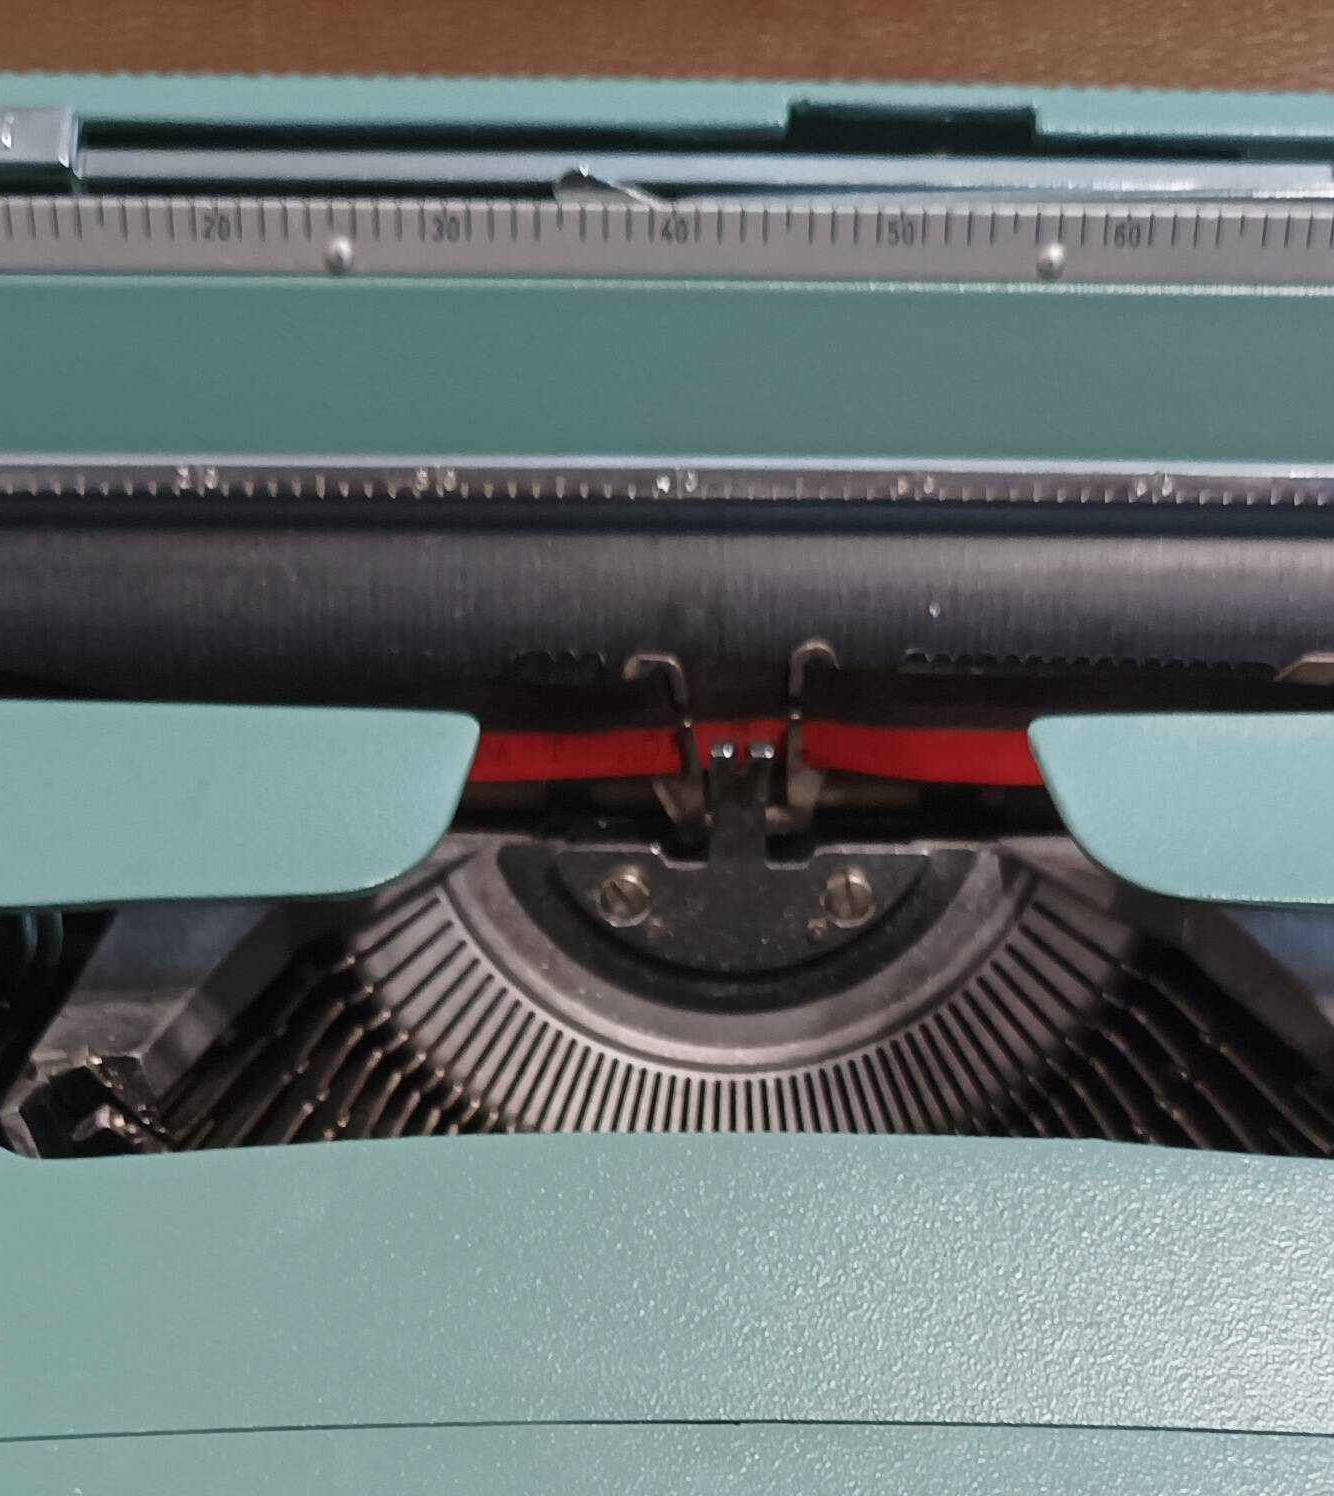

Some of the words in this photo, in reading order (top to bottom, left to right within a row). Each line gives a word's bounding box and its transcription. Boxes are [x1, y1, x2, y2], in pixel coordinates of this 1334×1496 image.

[203, 214, 231, 241] 20
[432, 217, 460, 243] 30
[661, 218, 689, 245] 40
[887, 219, 915, 246] 50
[1113, 221, 1142, 249] 60
